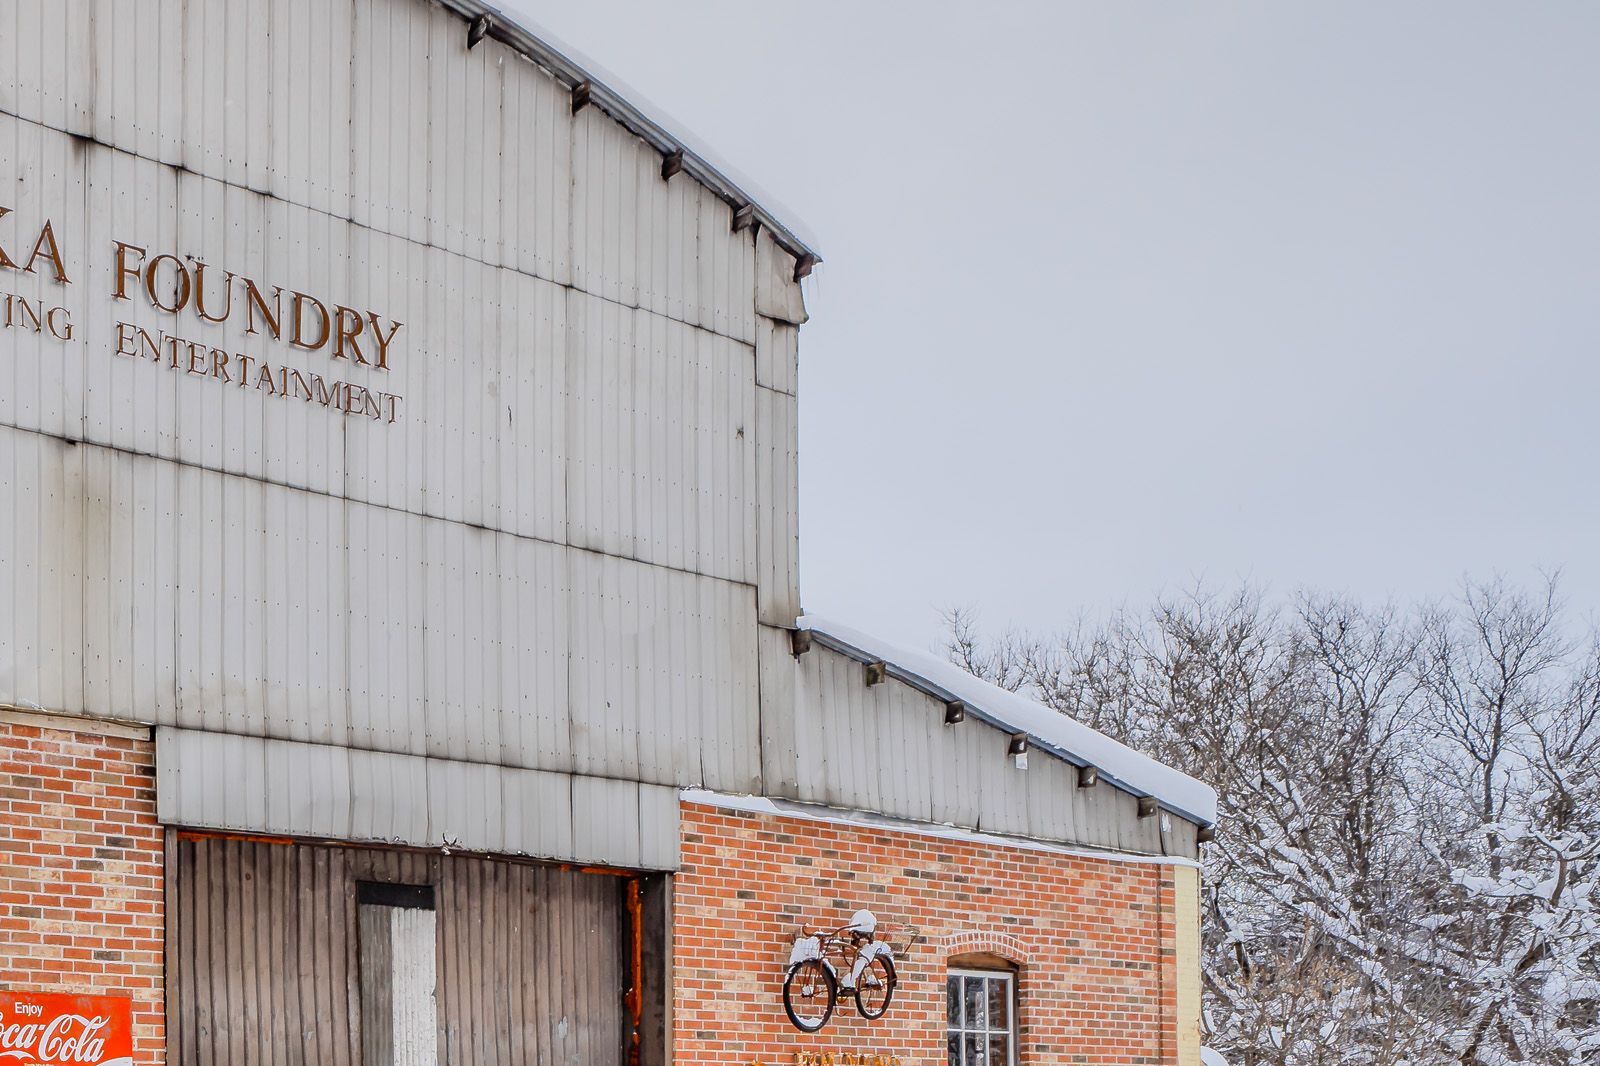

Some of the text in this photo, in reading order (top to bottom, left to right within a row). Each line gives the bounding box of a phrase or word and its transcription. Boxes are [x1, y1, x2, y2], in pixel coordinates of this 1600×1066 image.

[111, 240, 405, 372] FOUNDRY
[116, 321, 404, 425] ENTERTAINMENT
[15, 1001, 43, 1017] Enjoy
